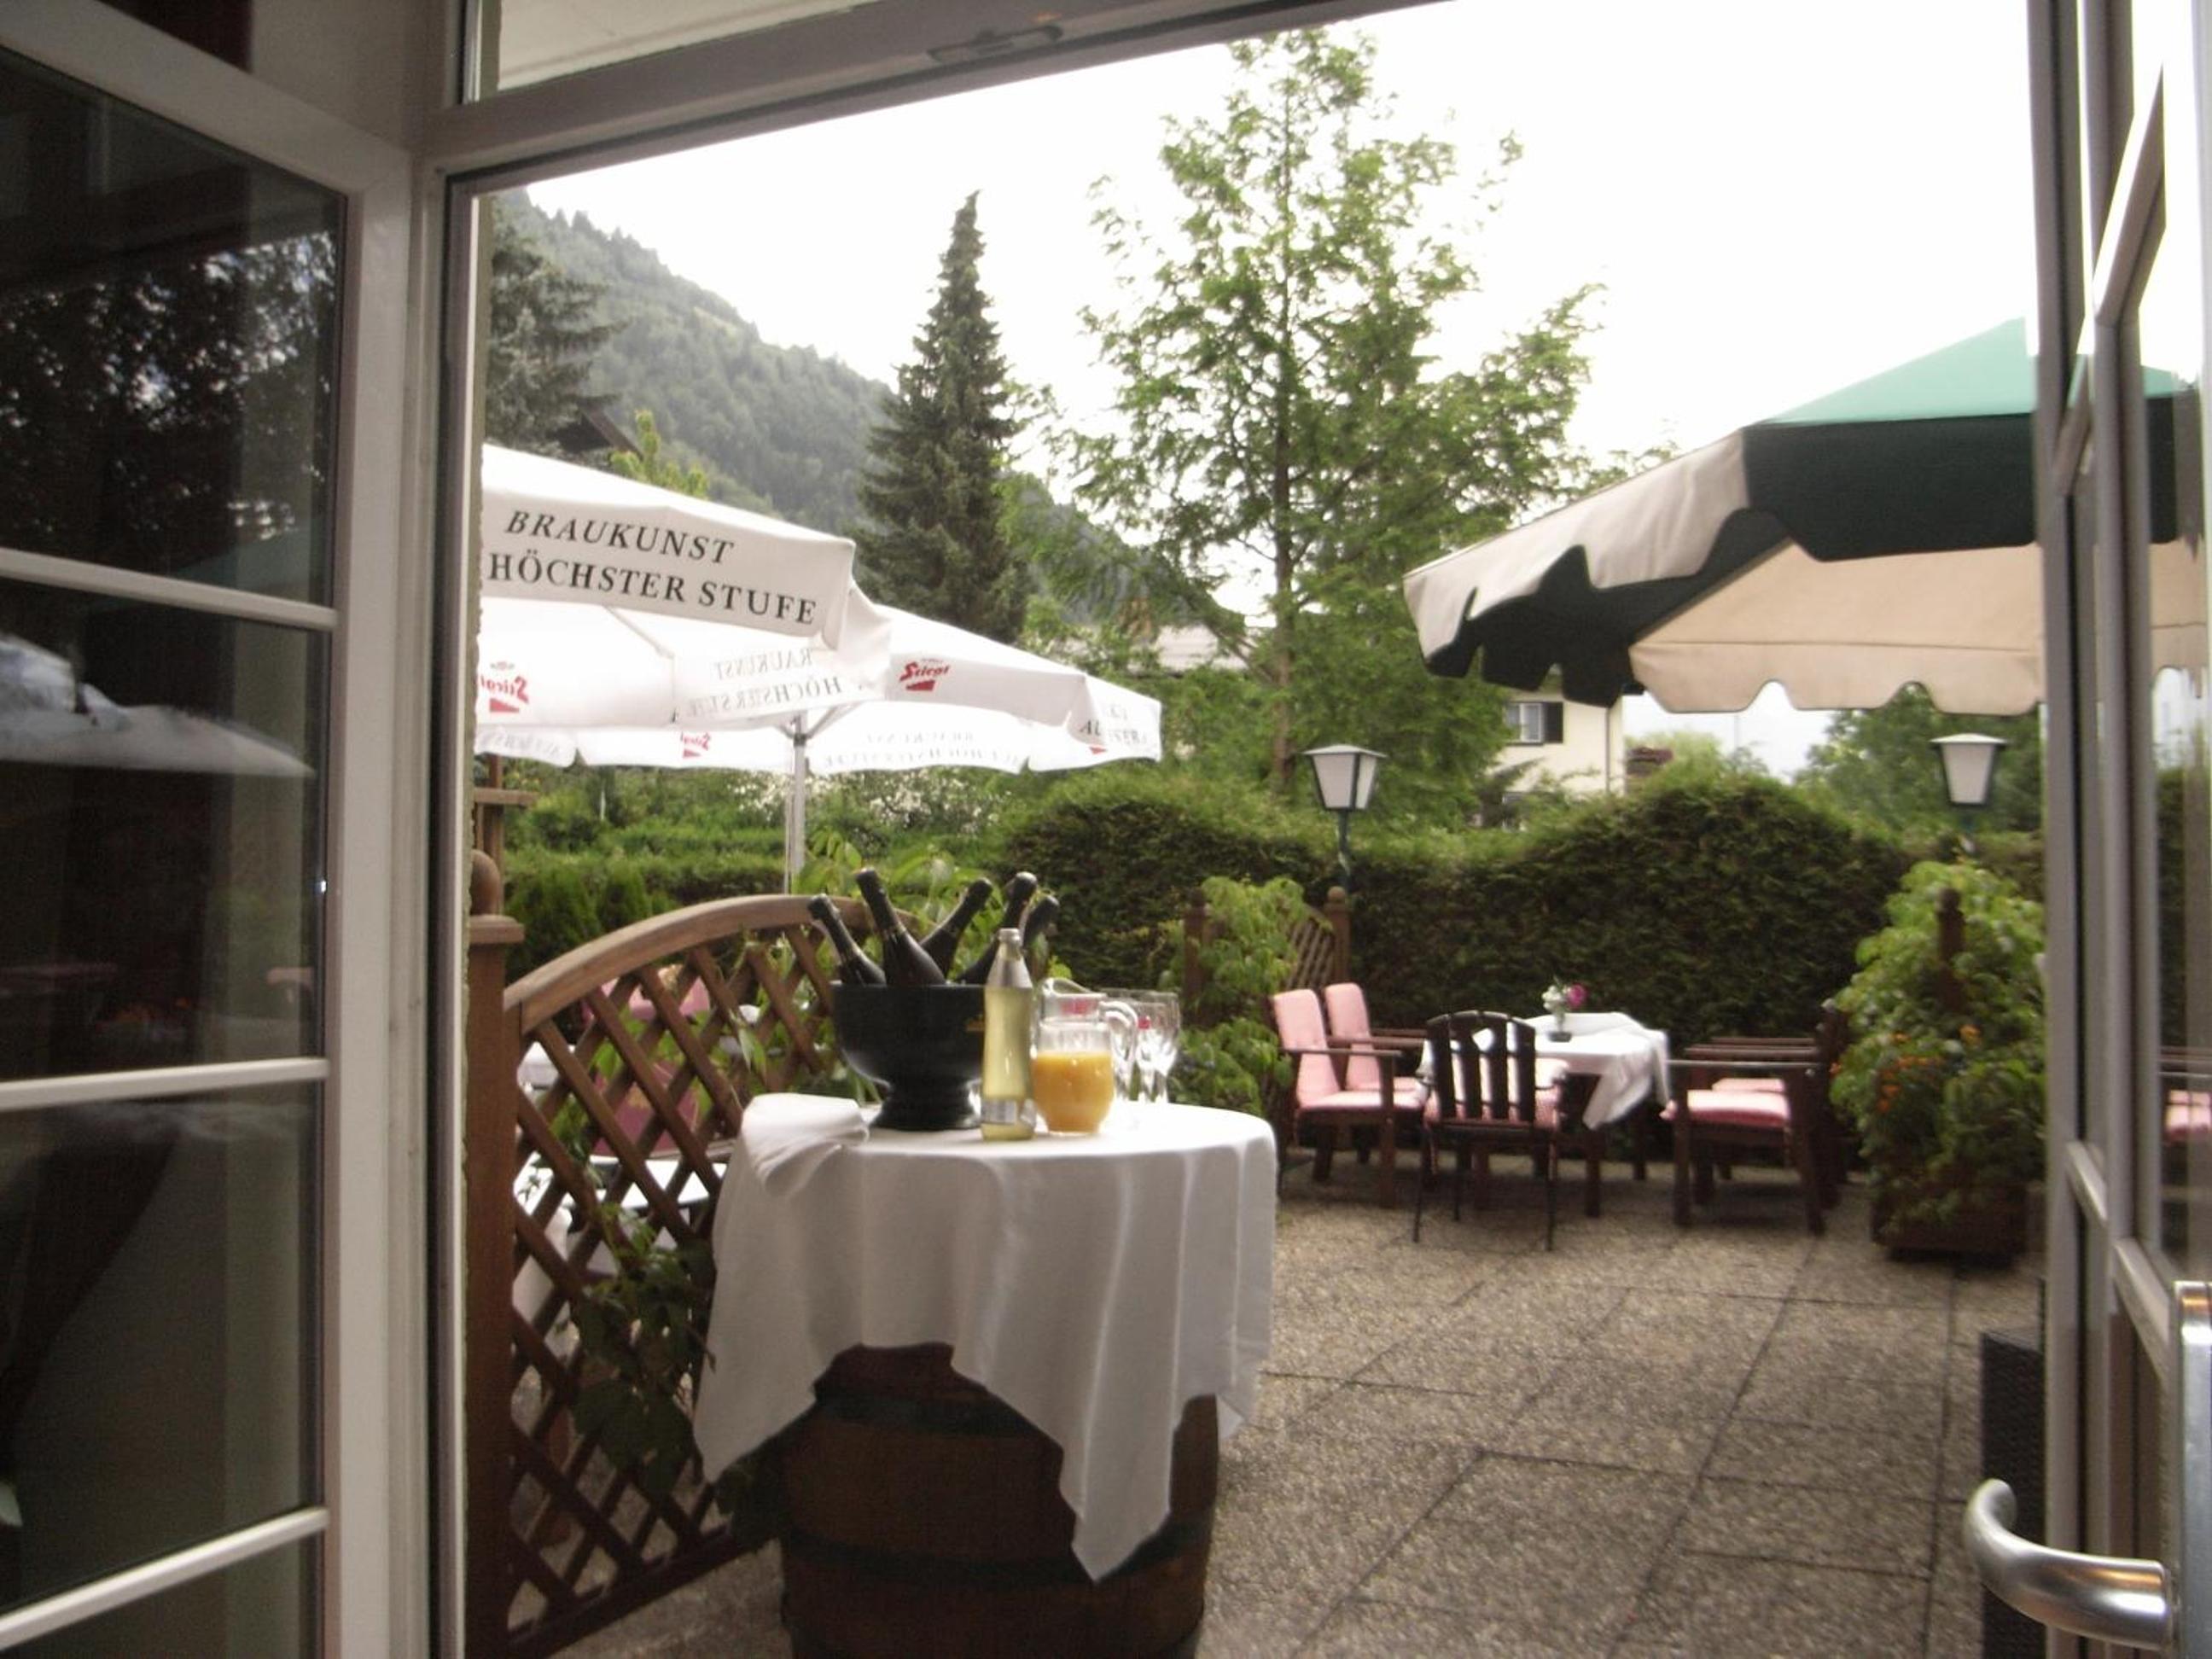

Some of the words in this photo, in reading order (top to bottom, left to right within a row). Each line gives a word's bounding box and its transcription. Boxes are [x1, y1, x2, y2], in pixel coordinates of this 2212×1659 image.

[505, 509, 734, 564] BRAUKUNST
[487, 549, 685, 602] HÖCHSTER
[697, 580, 818, 625] STUFE
